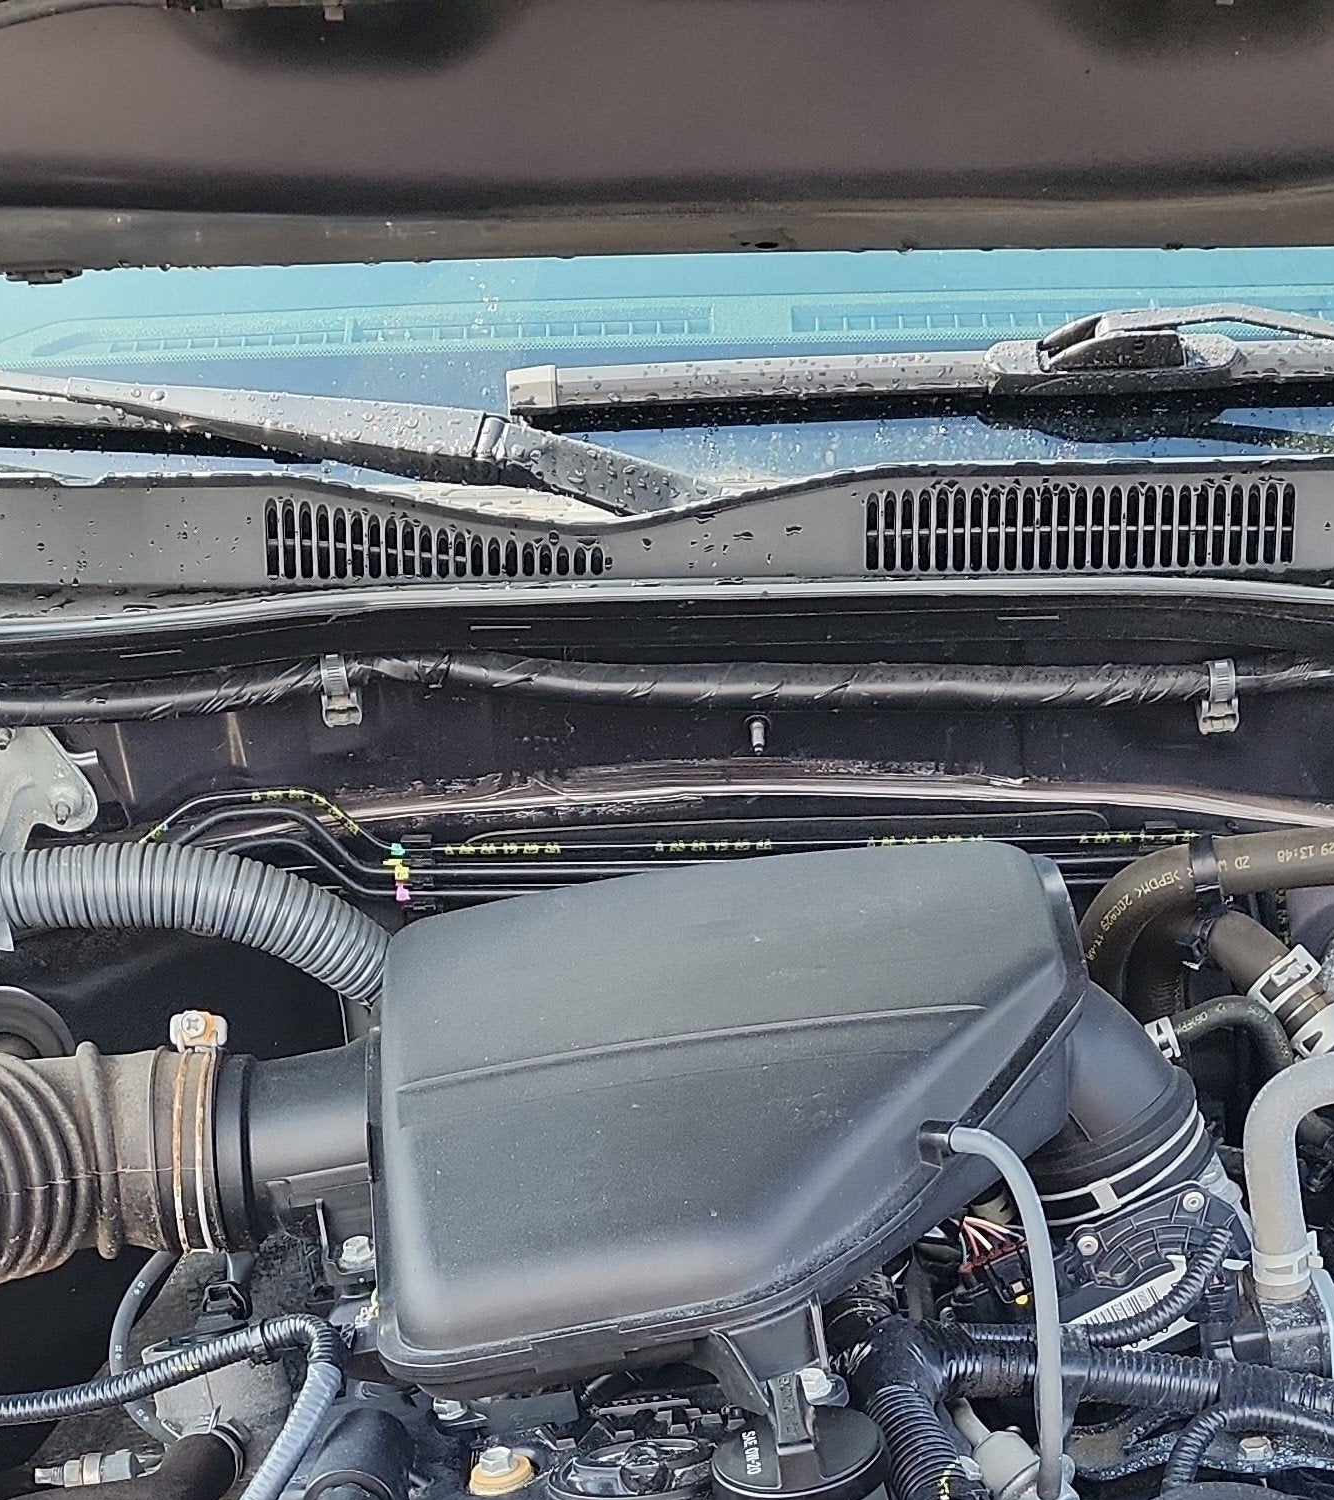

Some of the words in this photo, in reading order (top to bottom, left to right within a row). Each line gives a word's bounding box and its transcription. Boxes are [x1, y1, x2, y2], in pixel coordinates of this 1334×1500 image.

[1276, 844, 1315, 863] 13:48
[741, 1429, 758, 1449] SAE
[744, 1447, 762, 1476] 0W-20
